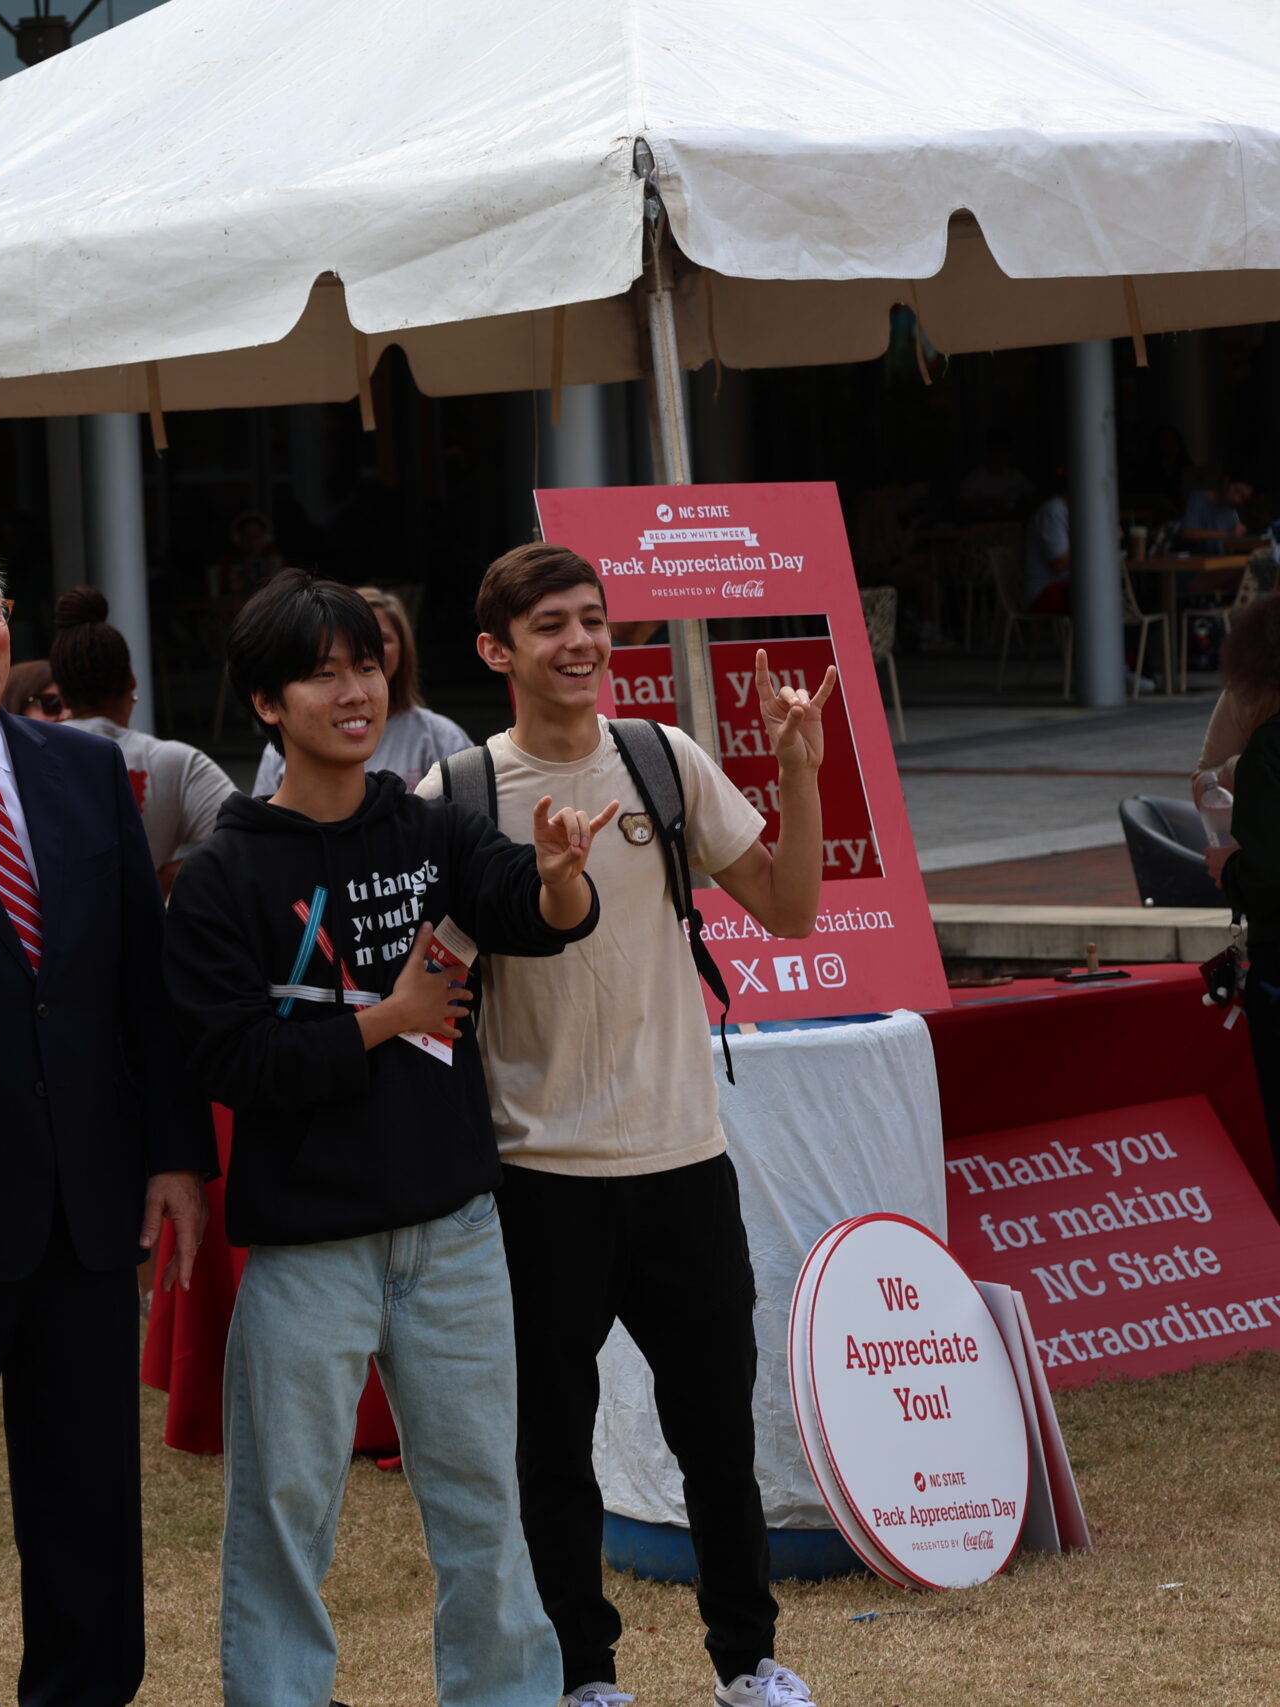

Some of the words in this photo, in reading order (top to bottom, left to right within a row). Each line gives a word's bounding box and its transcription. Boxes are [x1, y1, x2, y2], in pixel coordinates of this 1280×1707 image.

[678, 505, 695, 519] NC
[697, 505, 730, 519] STATE
[648, 532, 666, 541] RED
[670, 531, 688, 540] AND
[690, 530, 718, 540] WHITE
[721, 529, 746, 539] WEEK
[599, 556, 646, 576] Pack
[650, 553, 767, 577] Appreciation
[769, 552, 804, 574] Day
[651, 587, 703, 598] PRESENTED
[705, 586, 717, 596] BY
[945, 1140, 1094, 1195] Thank
[1091, 1131, 1178, 1178] you
[979, 1213, 1047, 1252] for
[1049, 1185, 1213, 1239] making
[1030, 1257, 1108, 1305] NC
[1107, 1244, 1222, 1291] State
[877, 1277, 920, 1312] We
[846, 1329, 979, 1376] Appreciate
[893, 1384, 951, 1422] You!
[929, 1473, 942, 1488] NC
[942, 1472, 966, 1487] STATE
[872, 1506, 907, 1528] Pack
[910, 1500, 991, 1528] Appreciation
[991, 1498, 1017, 1520] Day
[911, 1540, 950, 1551] PRESENTED
[951, 1539, 960, 1549] BY
